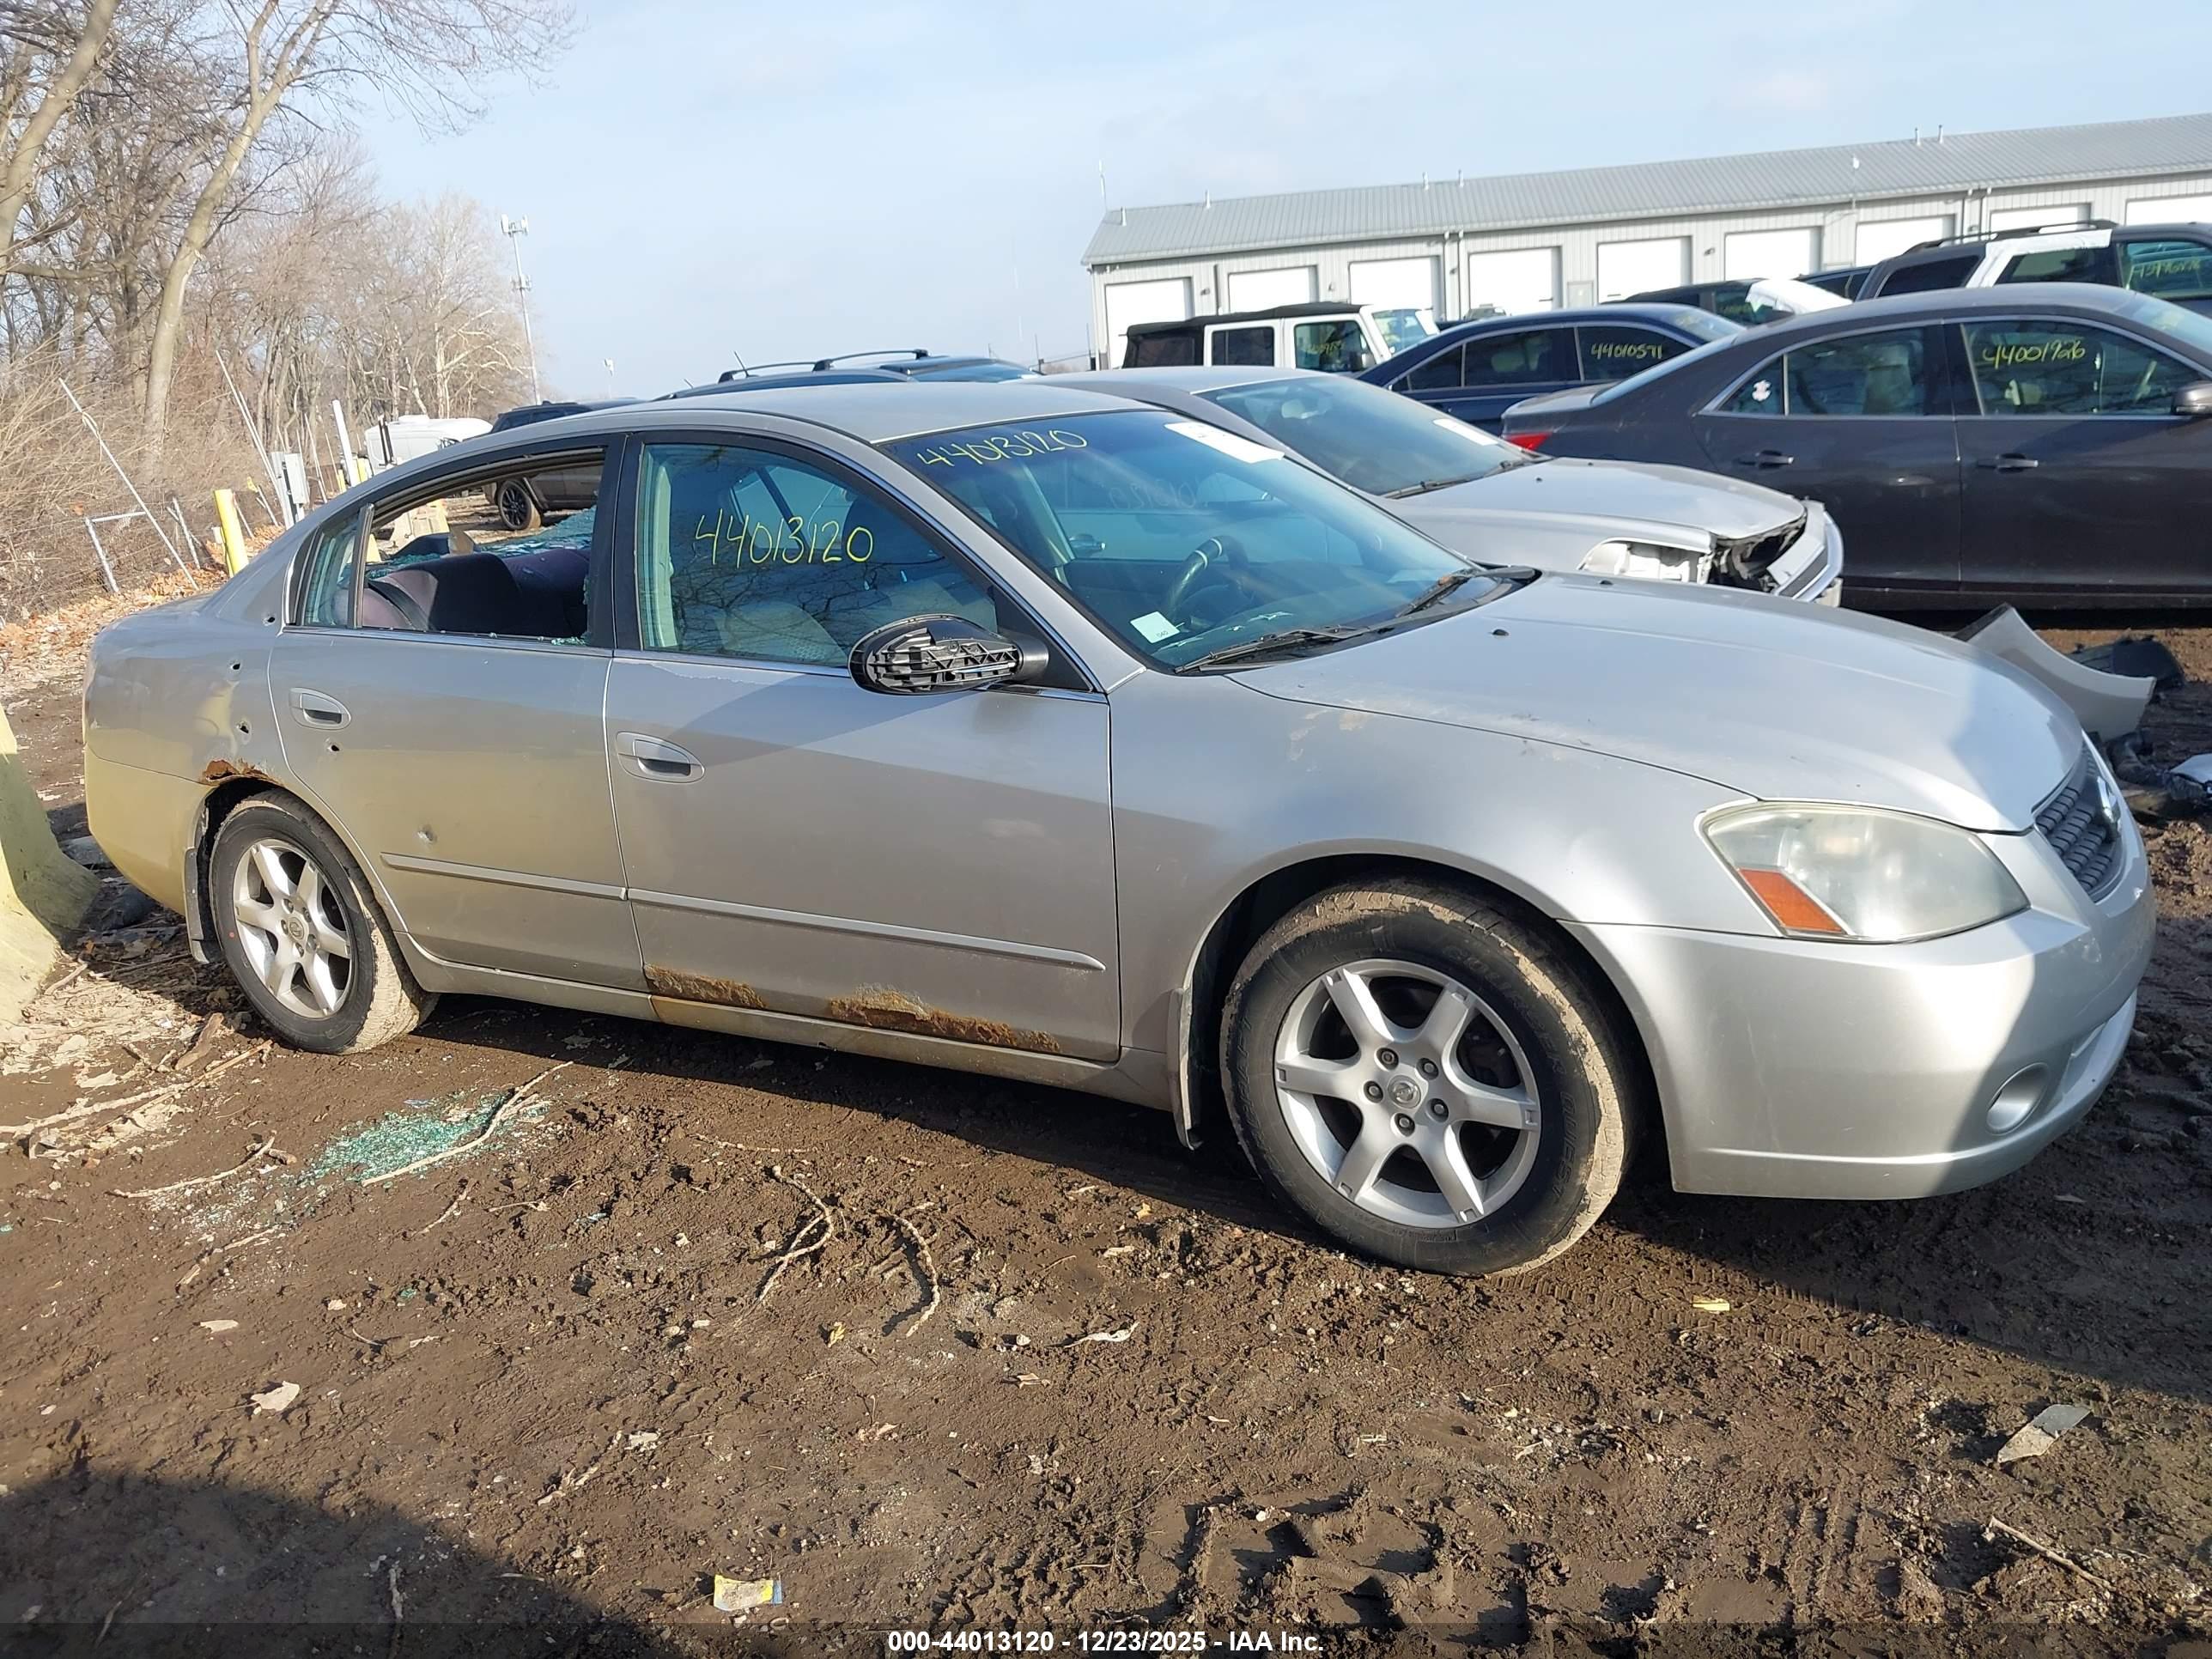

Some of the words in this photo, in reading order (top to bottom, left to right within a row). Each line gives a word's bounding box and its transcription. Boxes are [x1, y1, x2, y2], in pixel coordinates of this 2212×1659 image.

[916, 428, 1088, 468] 44013120
[694, 507, 874, 569] 44013120
[1549, 1091, 1578, 1199] QUEST
